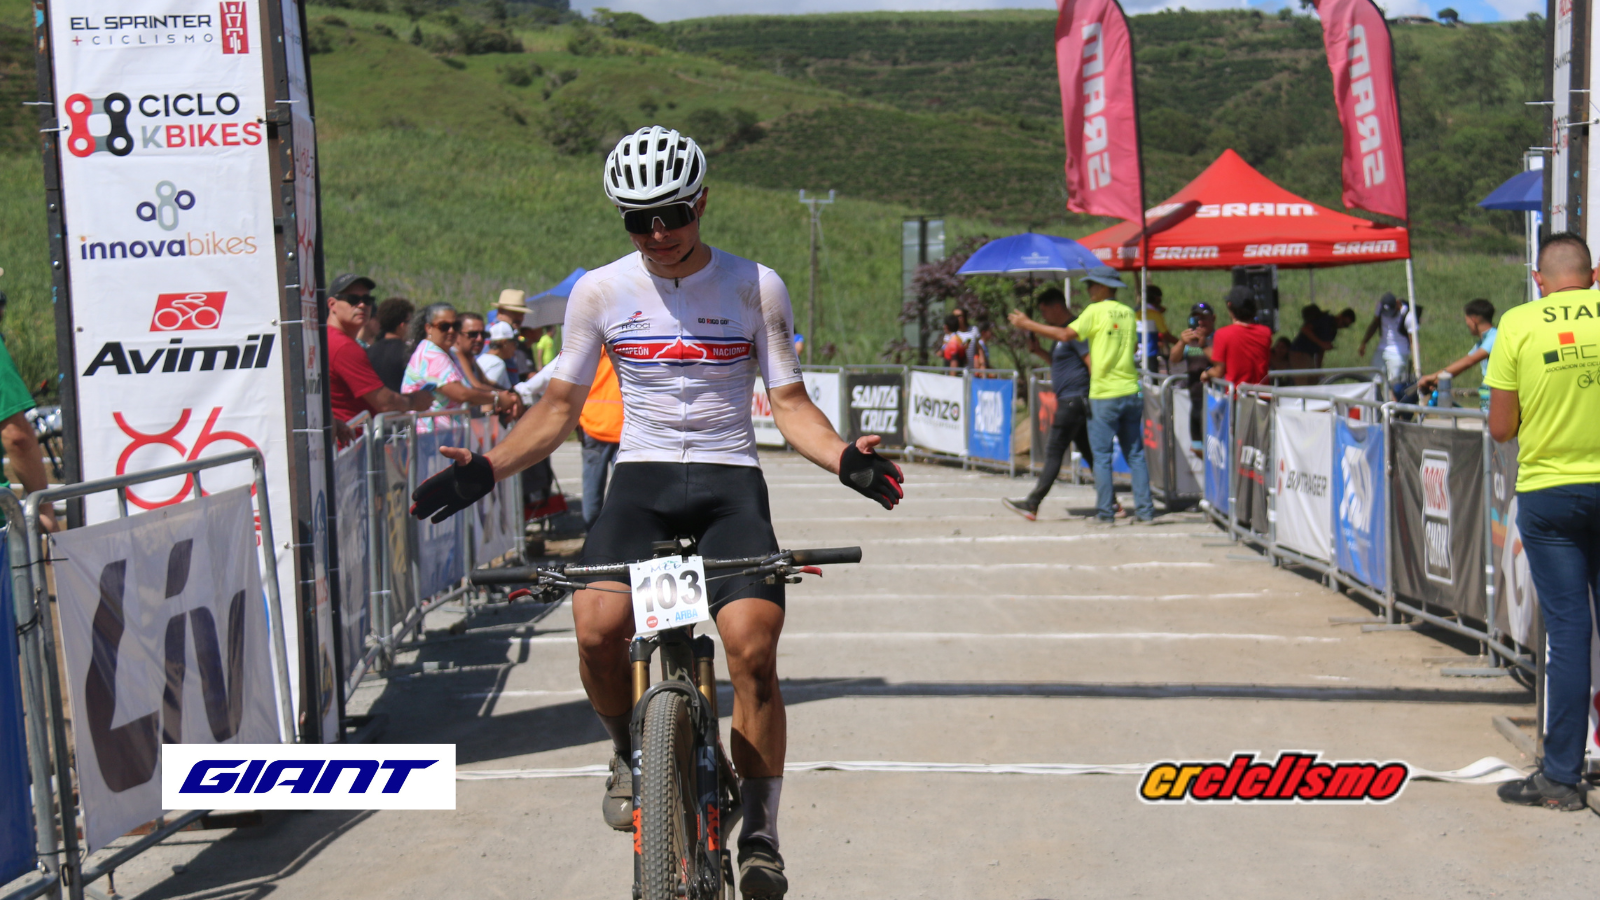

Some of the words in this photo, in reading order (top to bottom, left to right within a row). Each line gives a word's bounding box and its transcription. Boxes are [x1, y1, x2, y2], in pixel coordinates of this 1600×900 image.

[70, 17, 99, 30] EL
[104, 14, 212, 29] SPRINTER
[91, 33, 214, 45] CICLISMO
[139, 92, 240, 117] CICLO
[141, 122, 263, 149] KBIKES
[1195, 202, 1316, 218] SRAM
[80, 232, 258, 260] innovabikes
[1152, 245, 1219, 260] SRAM
[1243, 242, 1309, 258] SRAM
[1332, 239, 1397, 255] SRAM
[1542, 302, 1600, 323] STA
[82, 333, 275, 376] Avimil
[851, 385, 899, 408] SANTA
[860, 410, 898, 433] CRUZ
[636, 569, 702, 613] 103
